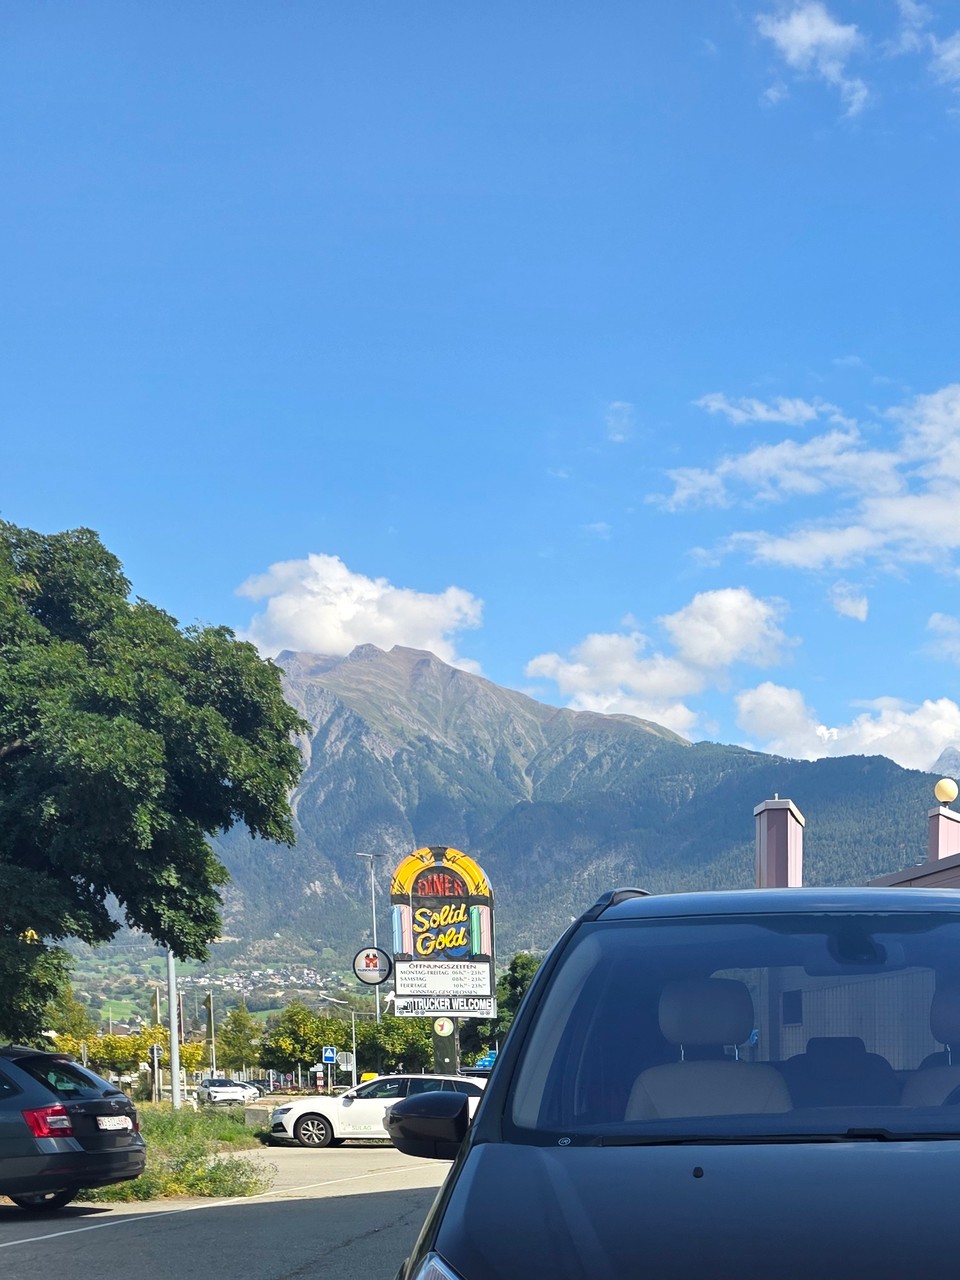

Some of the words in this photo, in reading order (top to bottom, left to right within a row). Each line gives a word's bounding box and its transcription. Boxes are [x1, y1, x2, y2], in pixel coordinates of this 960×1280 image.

[417, 873, 464, 897] DINER
[413, 904, 468, 933] Solid
[416, 926, 468, 955] Gold
[413, 998, 450, 1010] TRUCKER
[451, 998, 492, 1011] WELCOME
